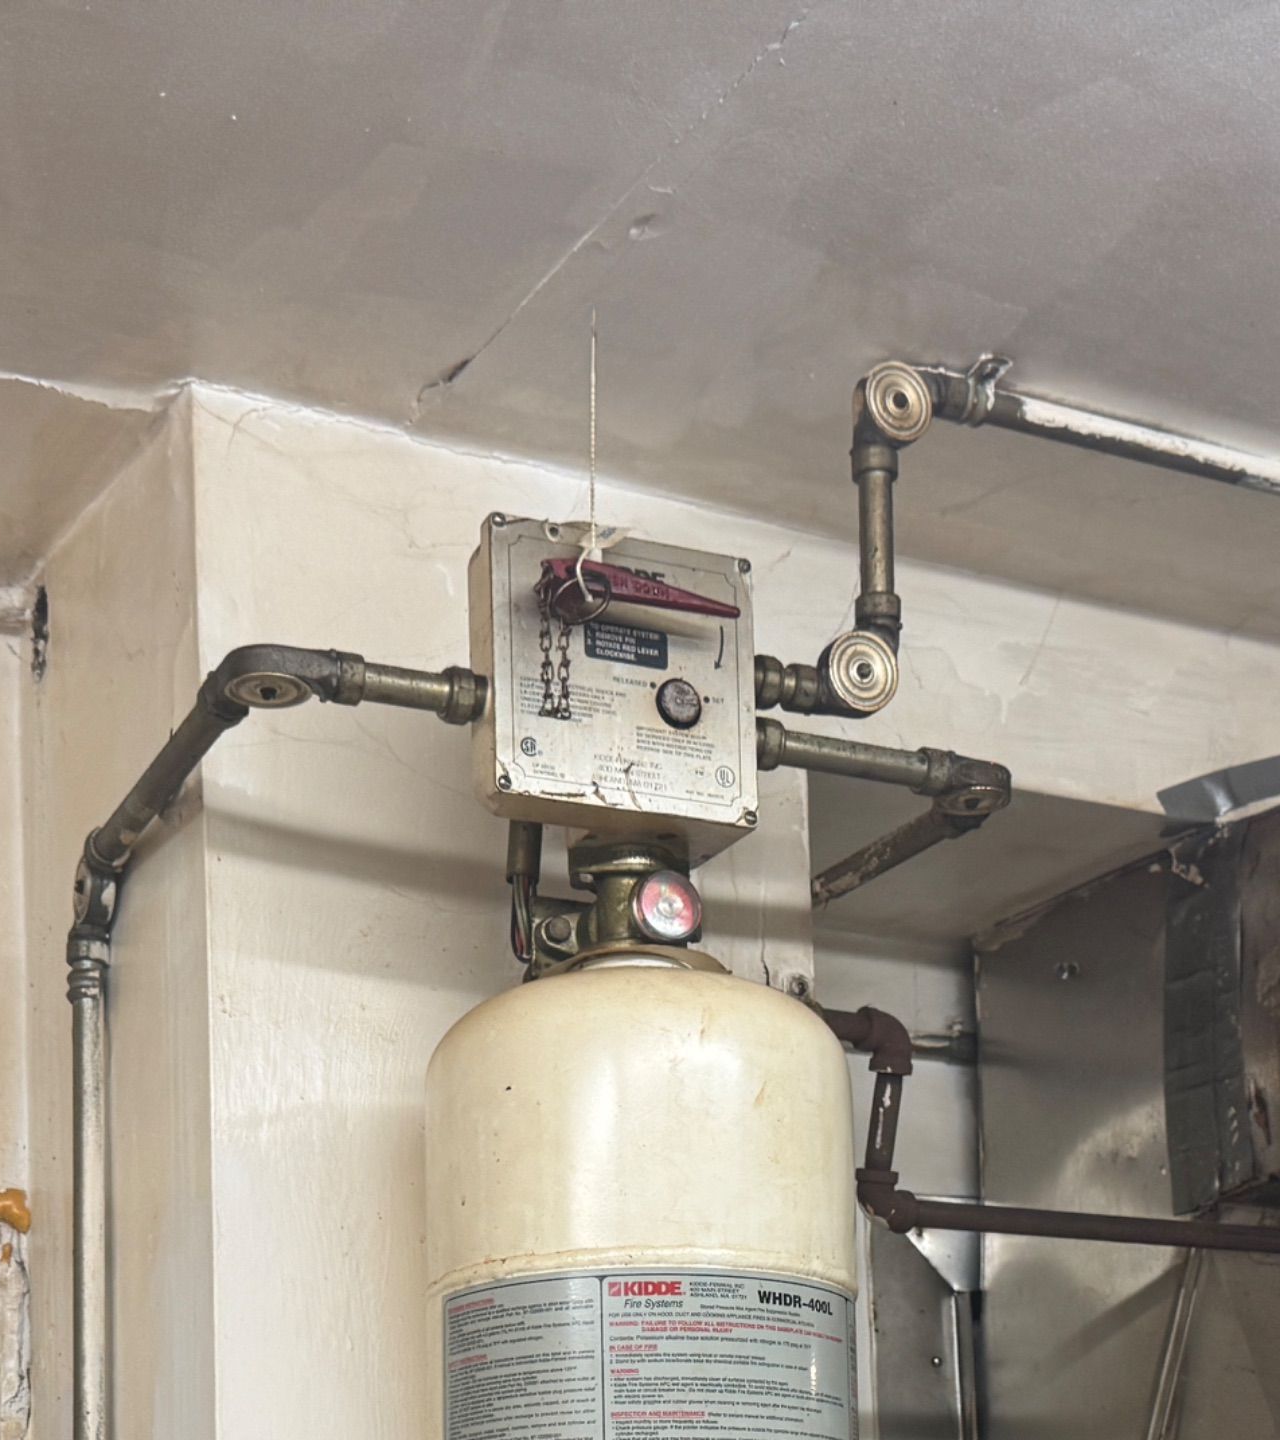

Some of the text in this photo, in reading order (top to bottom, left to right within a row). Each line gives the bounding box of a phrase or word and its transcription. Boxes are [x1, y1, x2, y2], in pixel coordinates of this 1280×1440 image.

[637, 646, 659, 656] LEVER
[613, 676, 648, 688] RELEASED
[624, 1281, 683, 1296] KIDDE
[624, 1299, 684, 1310] Fire Systems
[758, 1290, 833, 1316] WHDR-400L
